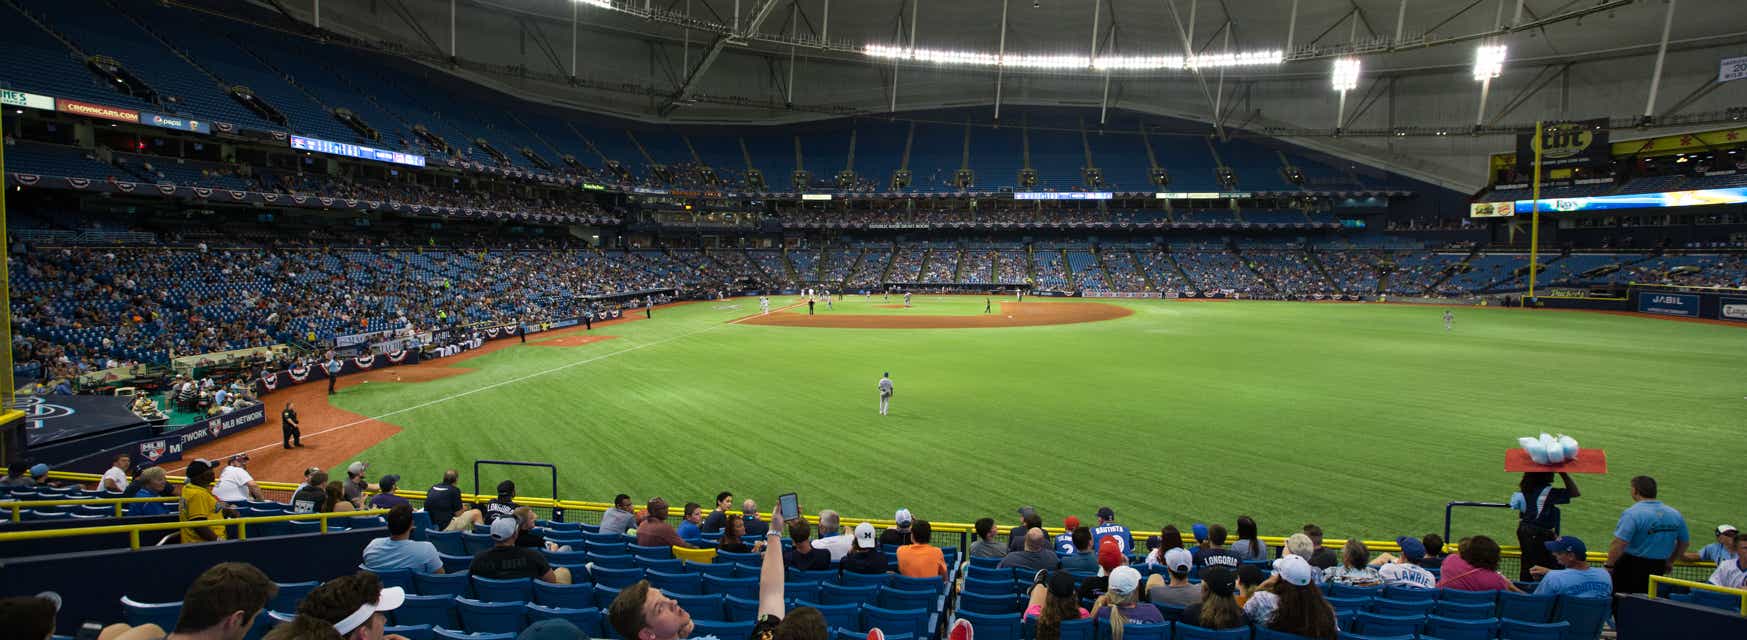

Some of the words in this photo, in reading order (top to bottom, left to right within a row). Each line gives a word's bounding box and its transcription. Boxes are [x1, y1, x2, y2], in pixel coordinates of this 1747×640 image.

[67, 103, 139, 120] CROWNCARS.COM
[163, 119, 182, 127] pepsi
[1652, 295, 1684, 305] JABIL
[220, 419, 235, 430] MLB
[235, 410, 263, 427] NETWORK
[142, 441, 164, 450] MLB
[1095, 525, 1124, 535] BAUTISTA
[1204, 555, 1238, 567] LONGORIA
[1393, 569, 1430, 586] LAWRIE
